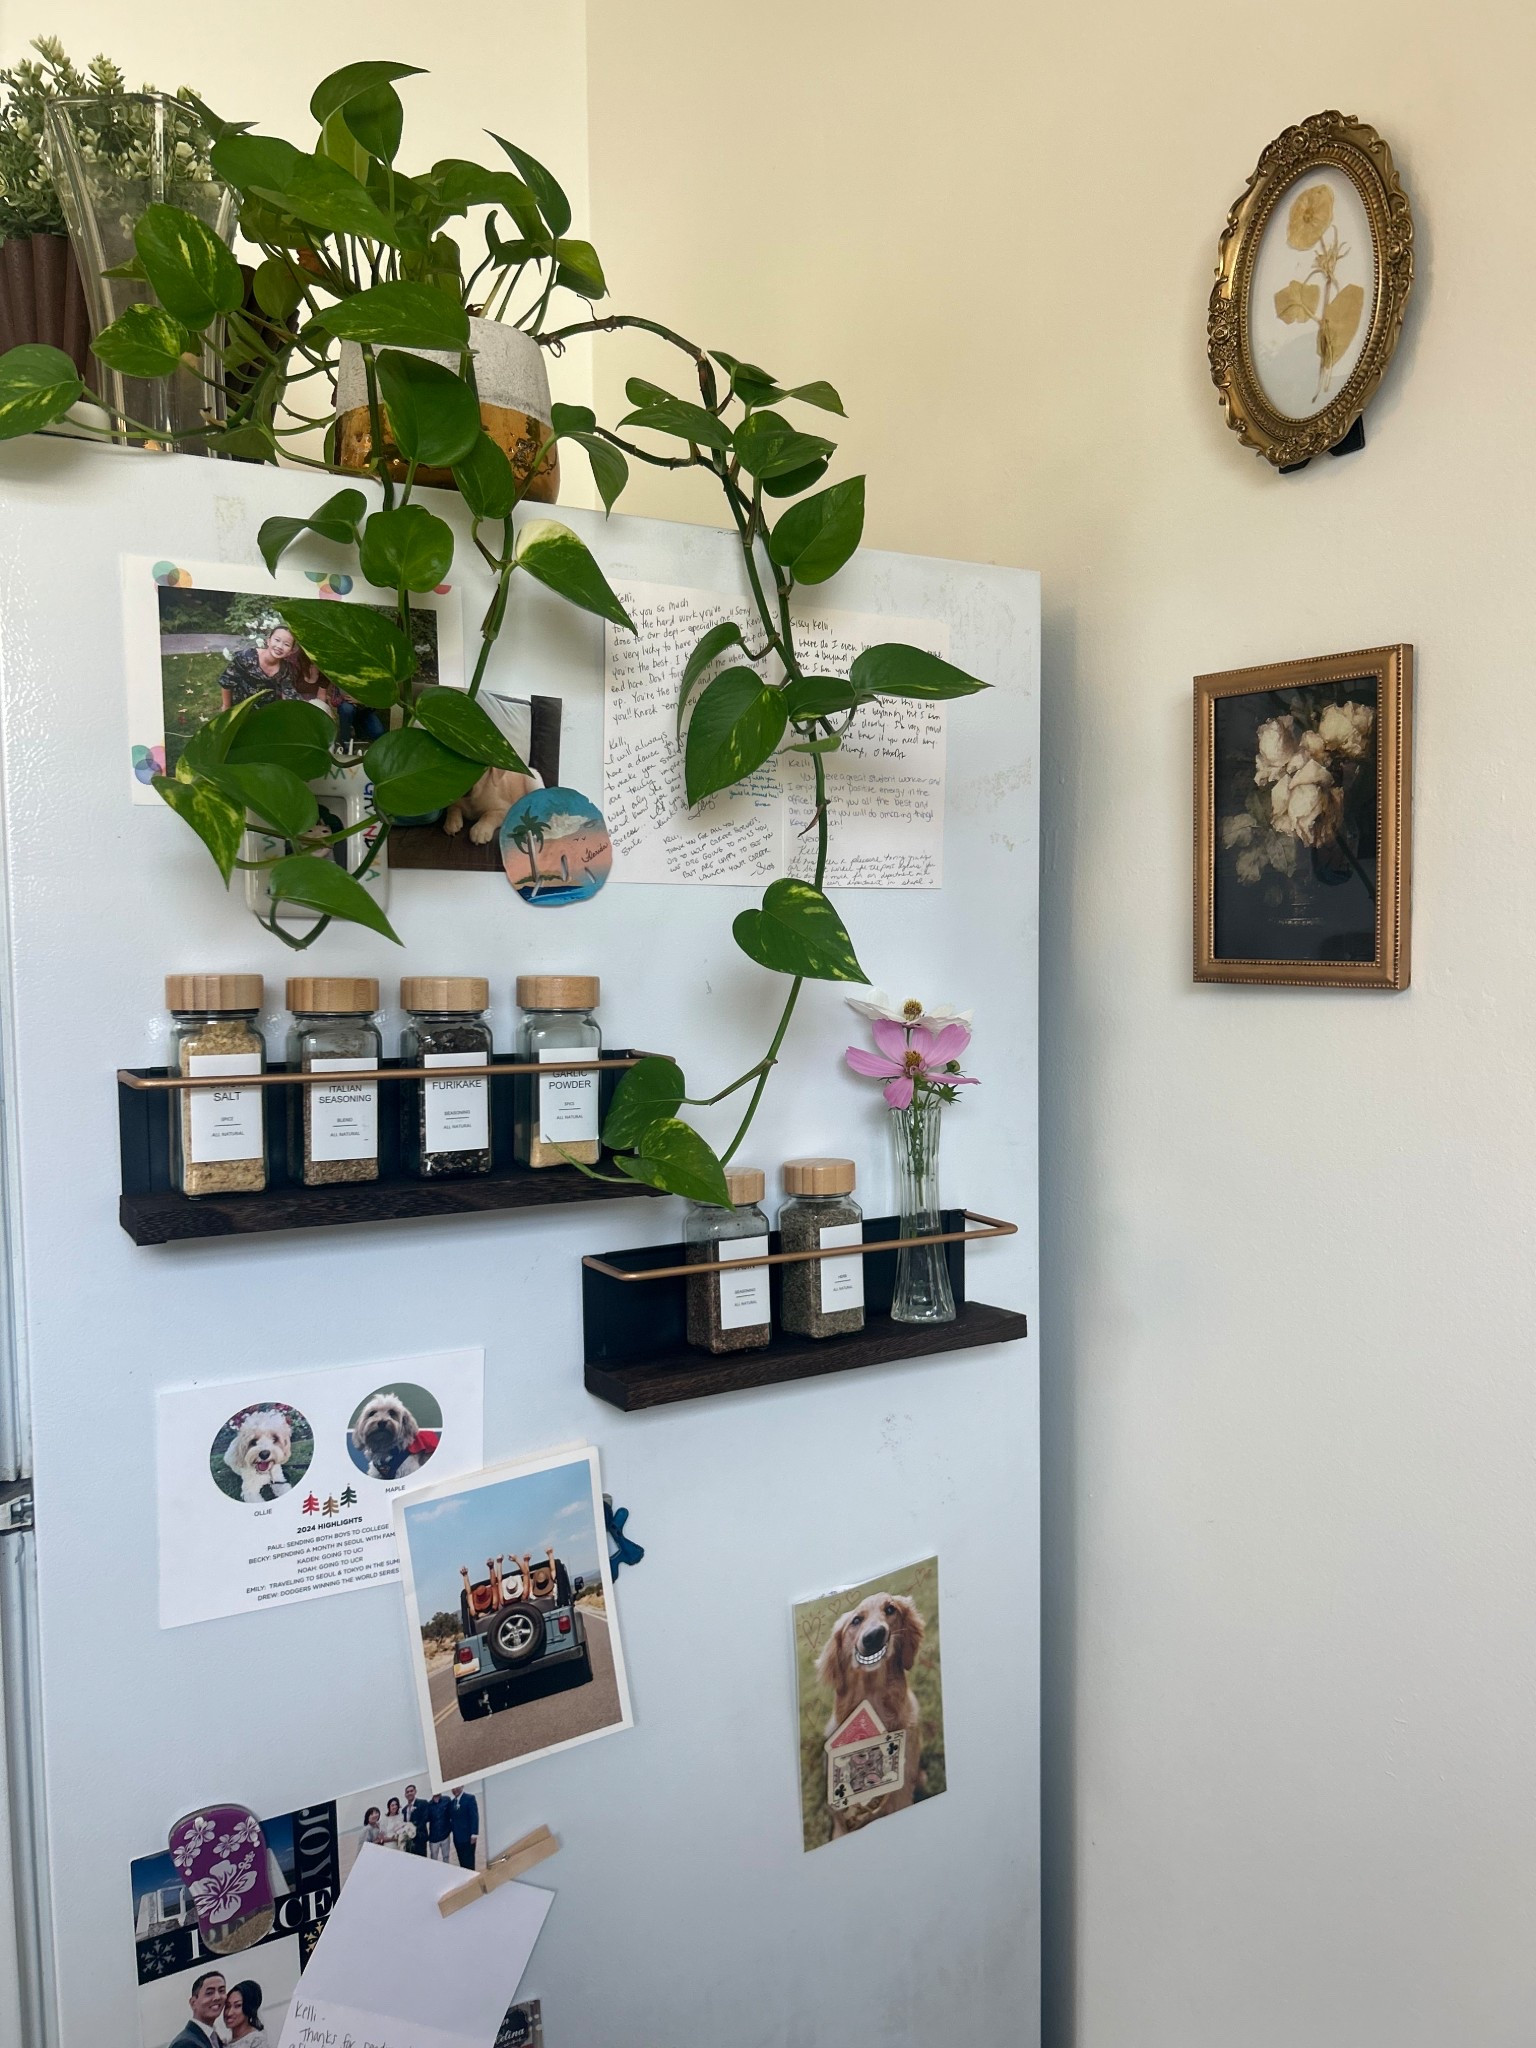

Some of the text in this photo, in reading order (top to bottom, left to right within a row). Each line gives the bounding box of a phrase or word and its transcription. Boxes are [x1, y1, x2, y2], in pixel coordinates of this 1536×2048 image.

[640, 608, 653, 621] you
[668, 598, 689, 610] much
[656, 615, 675, 627] hard
[679, 610, 698, 622] work
[789, 618, 810, 634] Sissy
[614, 636, 632, 646] done
[648, 631, 661, 639] our
[612, 640, 692, 662] is very lucky to have
[638, 662, 650, 672] the
[675, 655, 680, 665] I
[611, 653, 746, 692] end me when
[631, 673, 712, 703] You're the and
[633, 704, 658, 718] Knock
[925, 726, 942, 735] proud
[617, 732, 668, 762] will always
[902, 736, 919, 745] need
[635, 750, 660, 766] dance
[617, 772, 638, 788] make
[641, 764, 657, 778] you
[846, 773, 867, 785] great
[869, 773, 895, 784] student
[929, 776, 942, 786] and
[918, 787, 929, 797] the
[846, 799, 860, 808] you
[861, 795, 873, 806] all
[875, 797, 890, 806] the
[895, 797, 913, 808] best
[915, 799, 930, 808] and
[852, 810, 868, 818] will
[880, 812, 913, 824] amazing
[703, 848, 724, 861] GOING
[849, 855, 881, 868] pleasure
[683, 868, 697, 879] BUT
[552, 1070, 587, 1078] GARLIC
[329, 1085, 362, 1093] ITALIAN
[432, 1080, 482, 1090] FURIKAKE
[548, 1080, 592, 1090] POWDER
[213, 1092, 242, 1102] SALT
[319, 1095, 372, 1104] SEASONING
[385, 1484, 406, 1493] MAPLE
[253, 1508, 273, 1517] OLLIE
[297, 1516, 363, 1534] 2024 HIGHLIGHTS
[267, 1542, 286, 1551] PAUL:
[286, 1537, 315, 1548] SENDING
[315, 1534, 333, 1542] BOTH
[334, 1531, 351, 1539] BOYS
[362, 1524, 390, 1533] COLLEGE
[248, 1554, 271, 1565] BECKY:
[272, 1548, 304, 1559] SPENDING
[312, 1543, 335, 1552] MONTH
[344, 1537, 364, 1547] SEOUL
[297, 1555, 320, 1565] KADEN:
[321, 1551, 342, 1560] GOING
[353, 1547, 364, 1555] UCI
[297, 1564, 318, 1574] NOAH:
[318, 1560, 340, 1569] GOING
[350, 1556, 363, 1564] UCR
[246, 1584, 267, 1594] EMILY:
[269, 1577, 304, 1589] TRAVELING
[316, 1571, 336, 1580] SEOUL
[343, 1565, 364, 1574] TOKYO
[257, 1568, 400, 1601] DREW: DODGERS WINNING THE WORLD SERIES
[299, 1808, 332, 1880] JOY
[299, 2027, 338, 2046] Thanks
